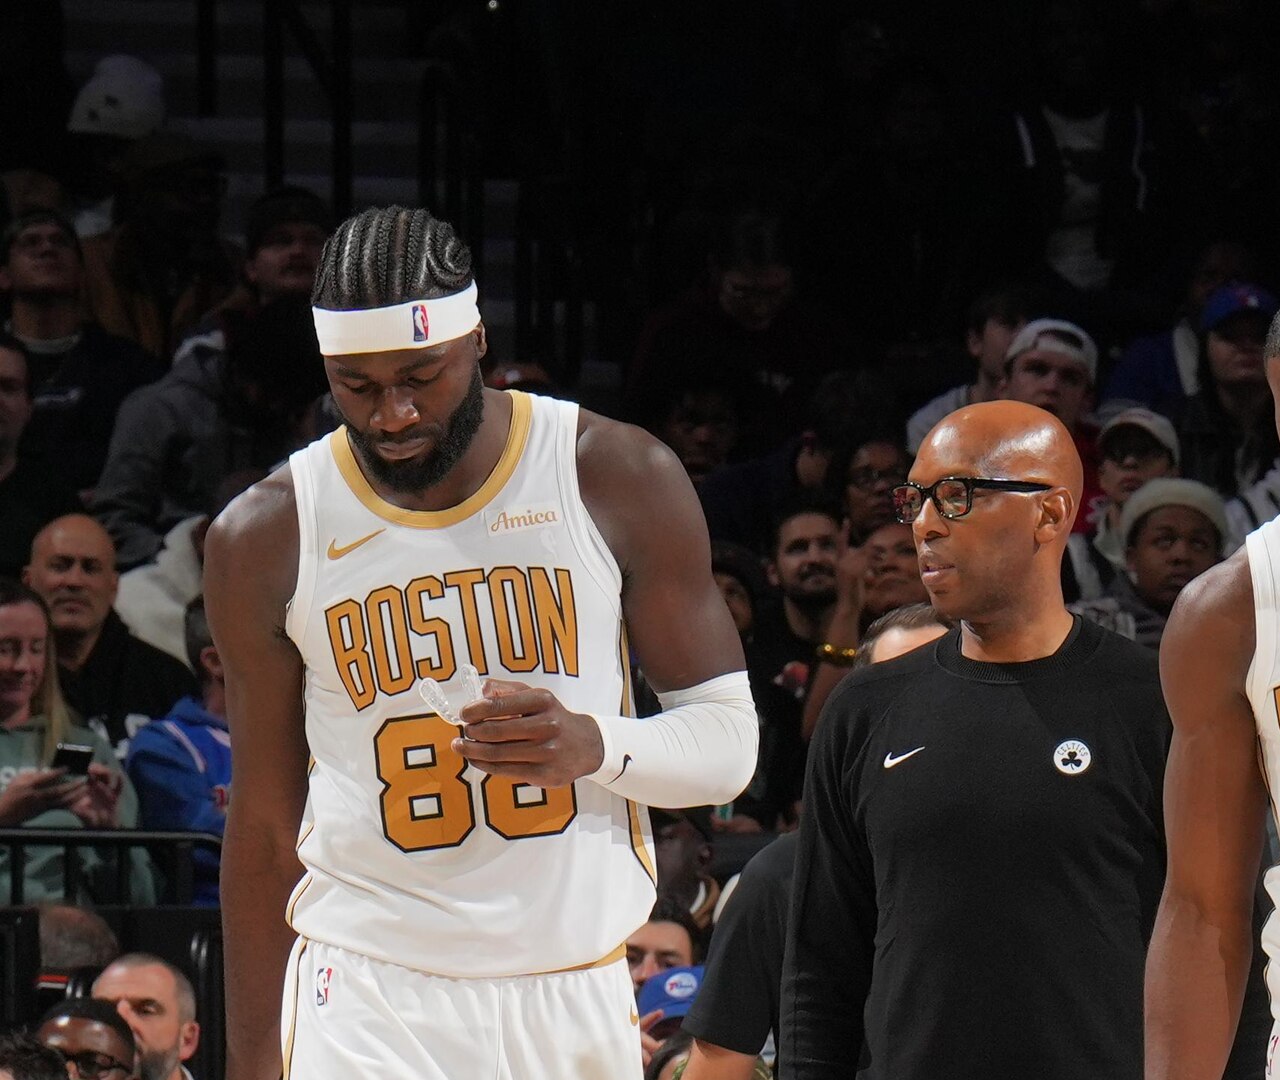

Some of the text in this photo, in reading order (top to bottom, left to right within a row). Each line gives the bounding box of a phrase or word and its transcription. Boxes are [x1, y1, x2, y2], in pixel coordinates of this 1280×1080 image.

[491, 509, 558, 532] Amica
[324, 565, 580, 713] BOSTON
[1057, 742, 1089, 757] CELTICS
